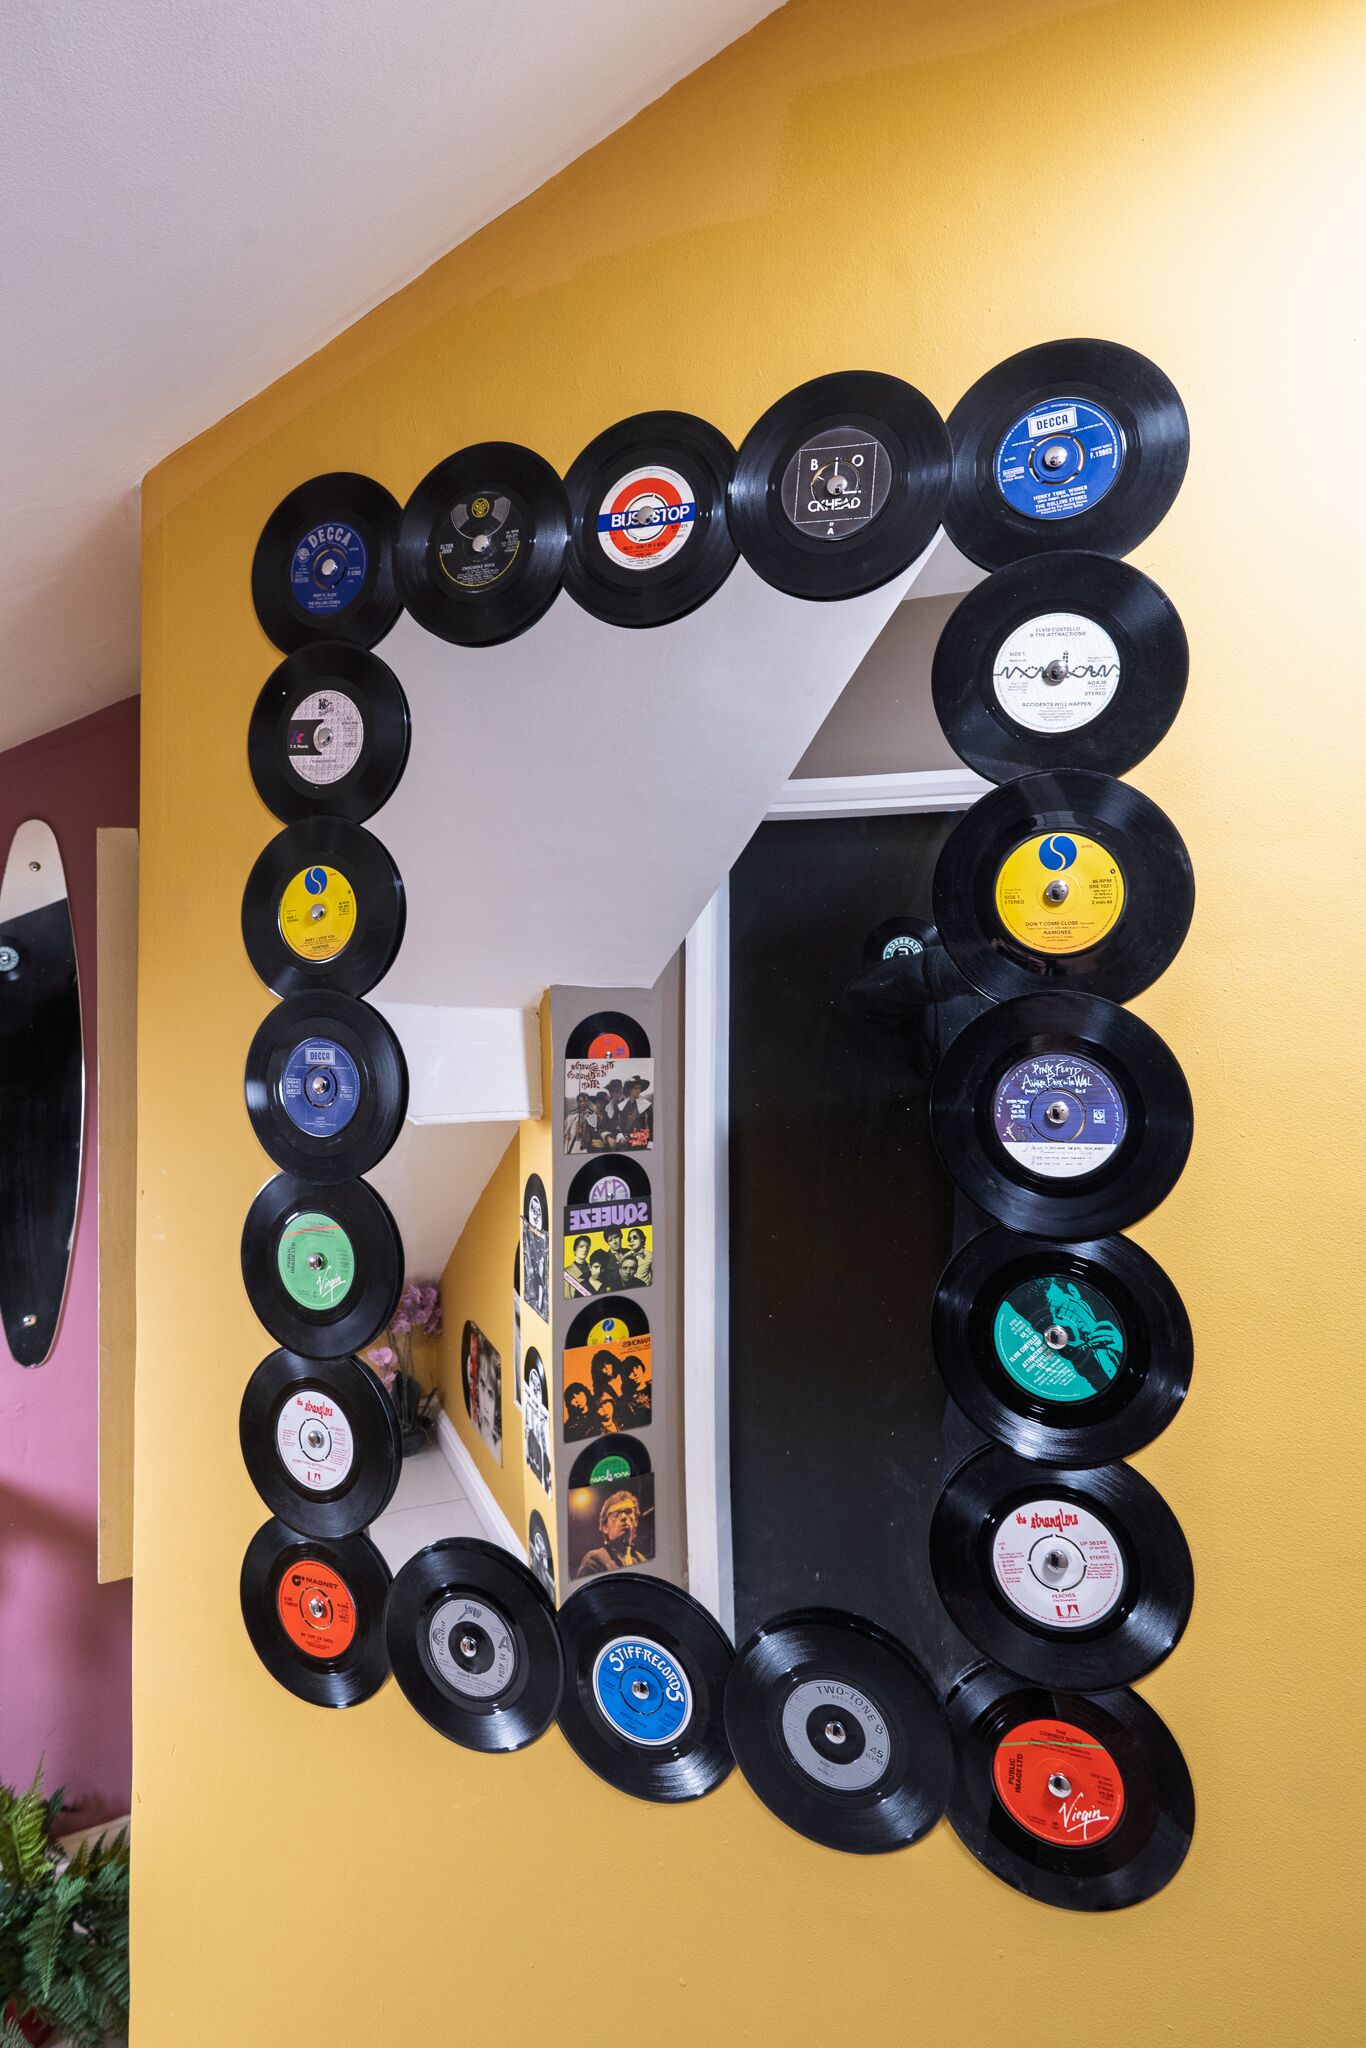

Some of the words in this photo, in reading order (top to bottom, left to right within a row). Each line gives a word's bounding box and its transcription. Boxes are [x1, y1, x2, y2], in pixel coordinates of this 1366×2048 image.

[1036, 414, 1068, 430] DECCA
[807, 497, 861, 512] CKHEAD
[652, 505, 690, 523] STOP
[308, 526, 352, 548] DECCA
[310, 1052, 330, 1060] DECCA
[1032, 1063, 1053, 1075] PINK
[1055, 1062, 1082, 1077] FLOYD
[317, 1265, 346, 1302] Virgin
[1009, 1350, 1022, 1363] ELVIS
[1019, 1334, 1039, 1353] COSTELLO
[1021, 1344, 1047, 1368] ATTRACTIONS
[304, 1400, 333, 1419] stranglers
[1016, 1513, 1027, 1524] the
[1030, 1508, 1079, 1533] stranglers
[306, 1578, 338, 1589] MAGNET
[816, 1686, 877, 1722] TWO-TONE
[1040, 1731, 1064, 1740] COWBOY
[866, 1753, 883, 1766] RPM
[871, 1747, 883, 1758] 45
[1059, 1792, 1109, 1840] Virgin
